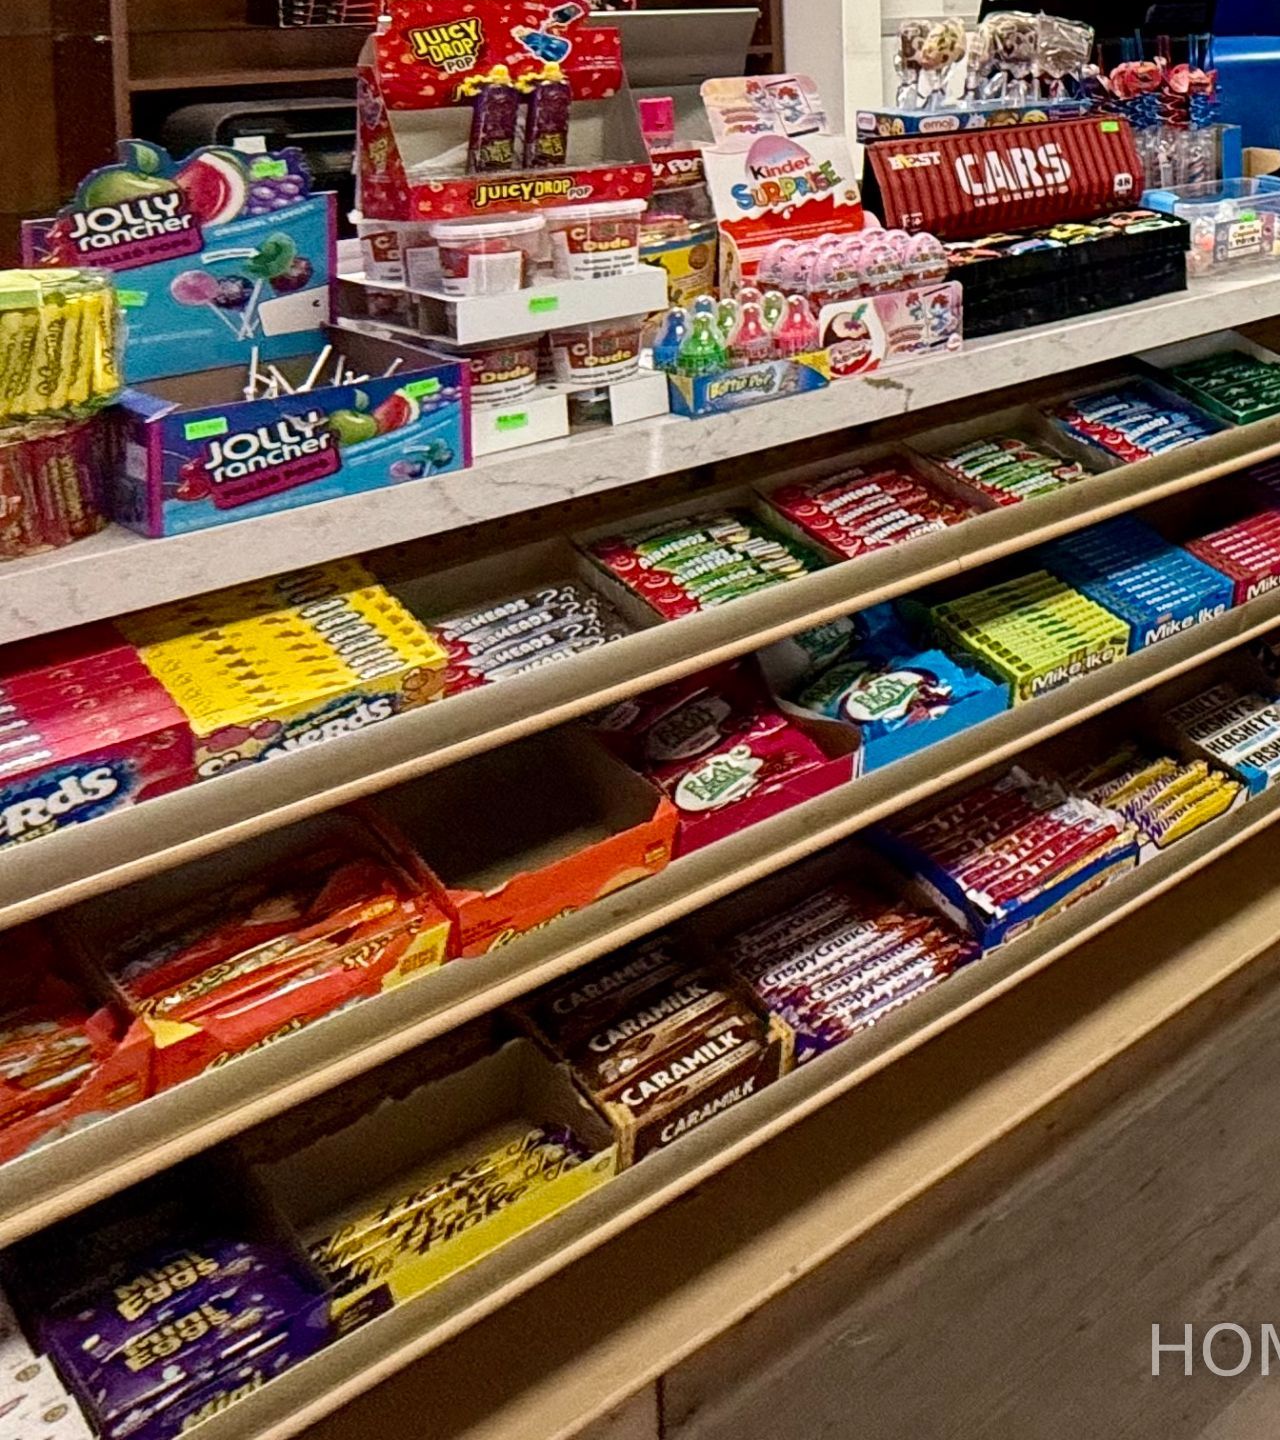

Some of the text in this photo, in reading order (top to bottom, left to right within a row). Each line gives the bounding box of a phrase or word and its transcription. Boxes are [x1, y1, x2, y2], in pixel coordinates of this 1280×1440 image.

[411, 19, 480, 55] JUICY
[428, 37, 475, 62] DROP
[446, 57, 474, 72] POP
[730, 160, 842, 210] SURPRISE
[749, 157, 811, 180] Kinder
[955, 142, 1072, 196] CARS
[69, 192, 181, 239] JOLLY
[476, 182, 536, 207] JUICY
[535, 179, 572, 195] DROP
[78, 213, 193, 253] rancher
[204, 411, 320, 471] JOLLY
[213, 432, 332, 483] rancher
[443, 598, 530, 641] AIRHEADS
[467, 610, 554, 656] AIRHEADS
[1144, 602, 1226, 646] Mike Ike
[1031, 647, 1115, 692] Mike Ike
[588, 981, 709, 1052] CARAMILK
[620, 1030, 742, 1106] CARAMILK
[660, 1076, 756, 1142] CARAMILK
[117, 1258, 220, 1322] Eggs
[125, 1309, 231, 1373] Eggs
